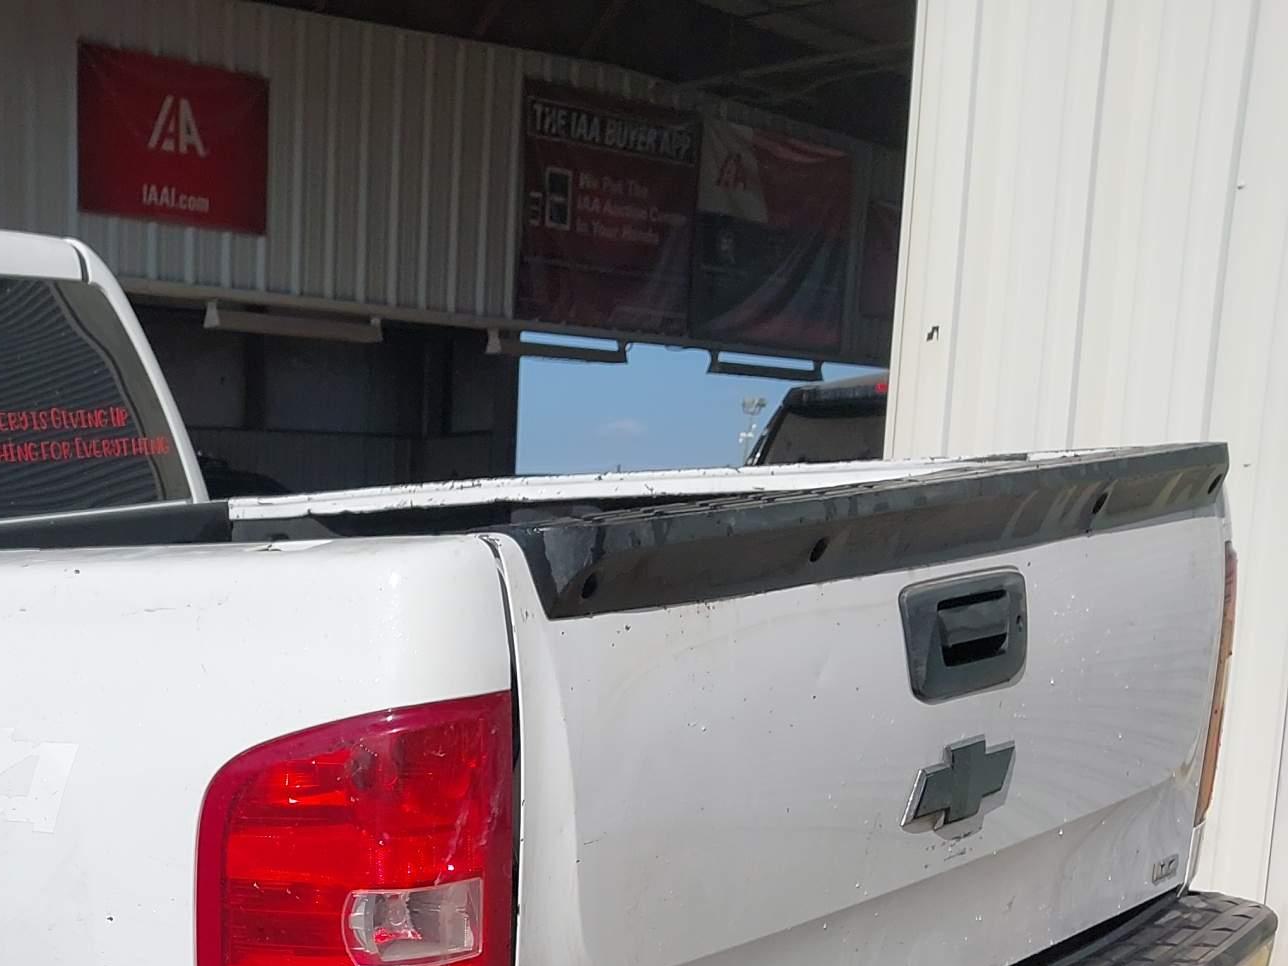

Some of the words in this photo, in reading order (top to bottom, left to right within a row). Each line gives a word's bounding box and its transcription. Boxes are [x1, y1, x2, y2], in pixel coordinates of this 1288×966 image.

[533, 103, 569, 138] THE
[571, 111, 600, 143] IAA
[604, 117, 657, 153] BUYER
[142, 183, 210, 213] IAAI.com
